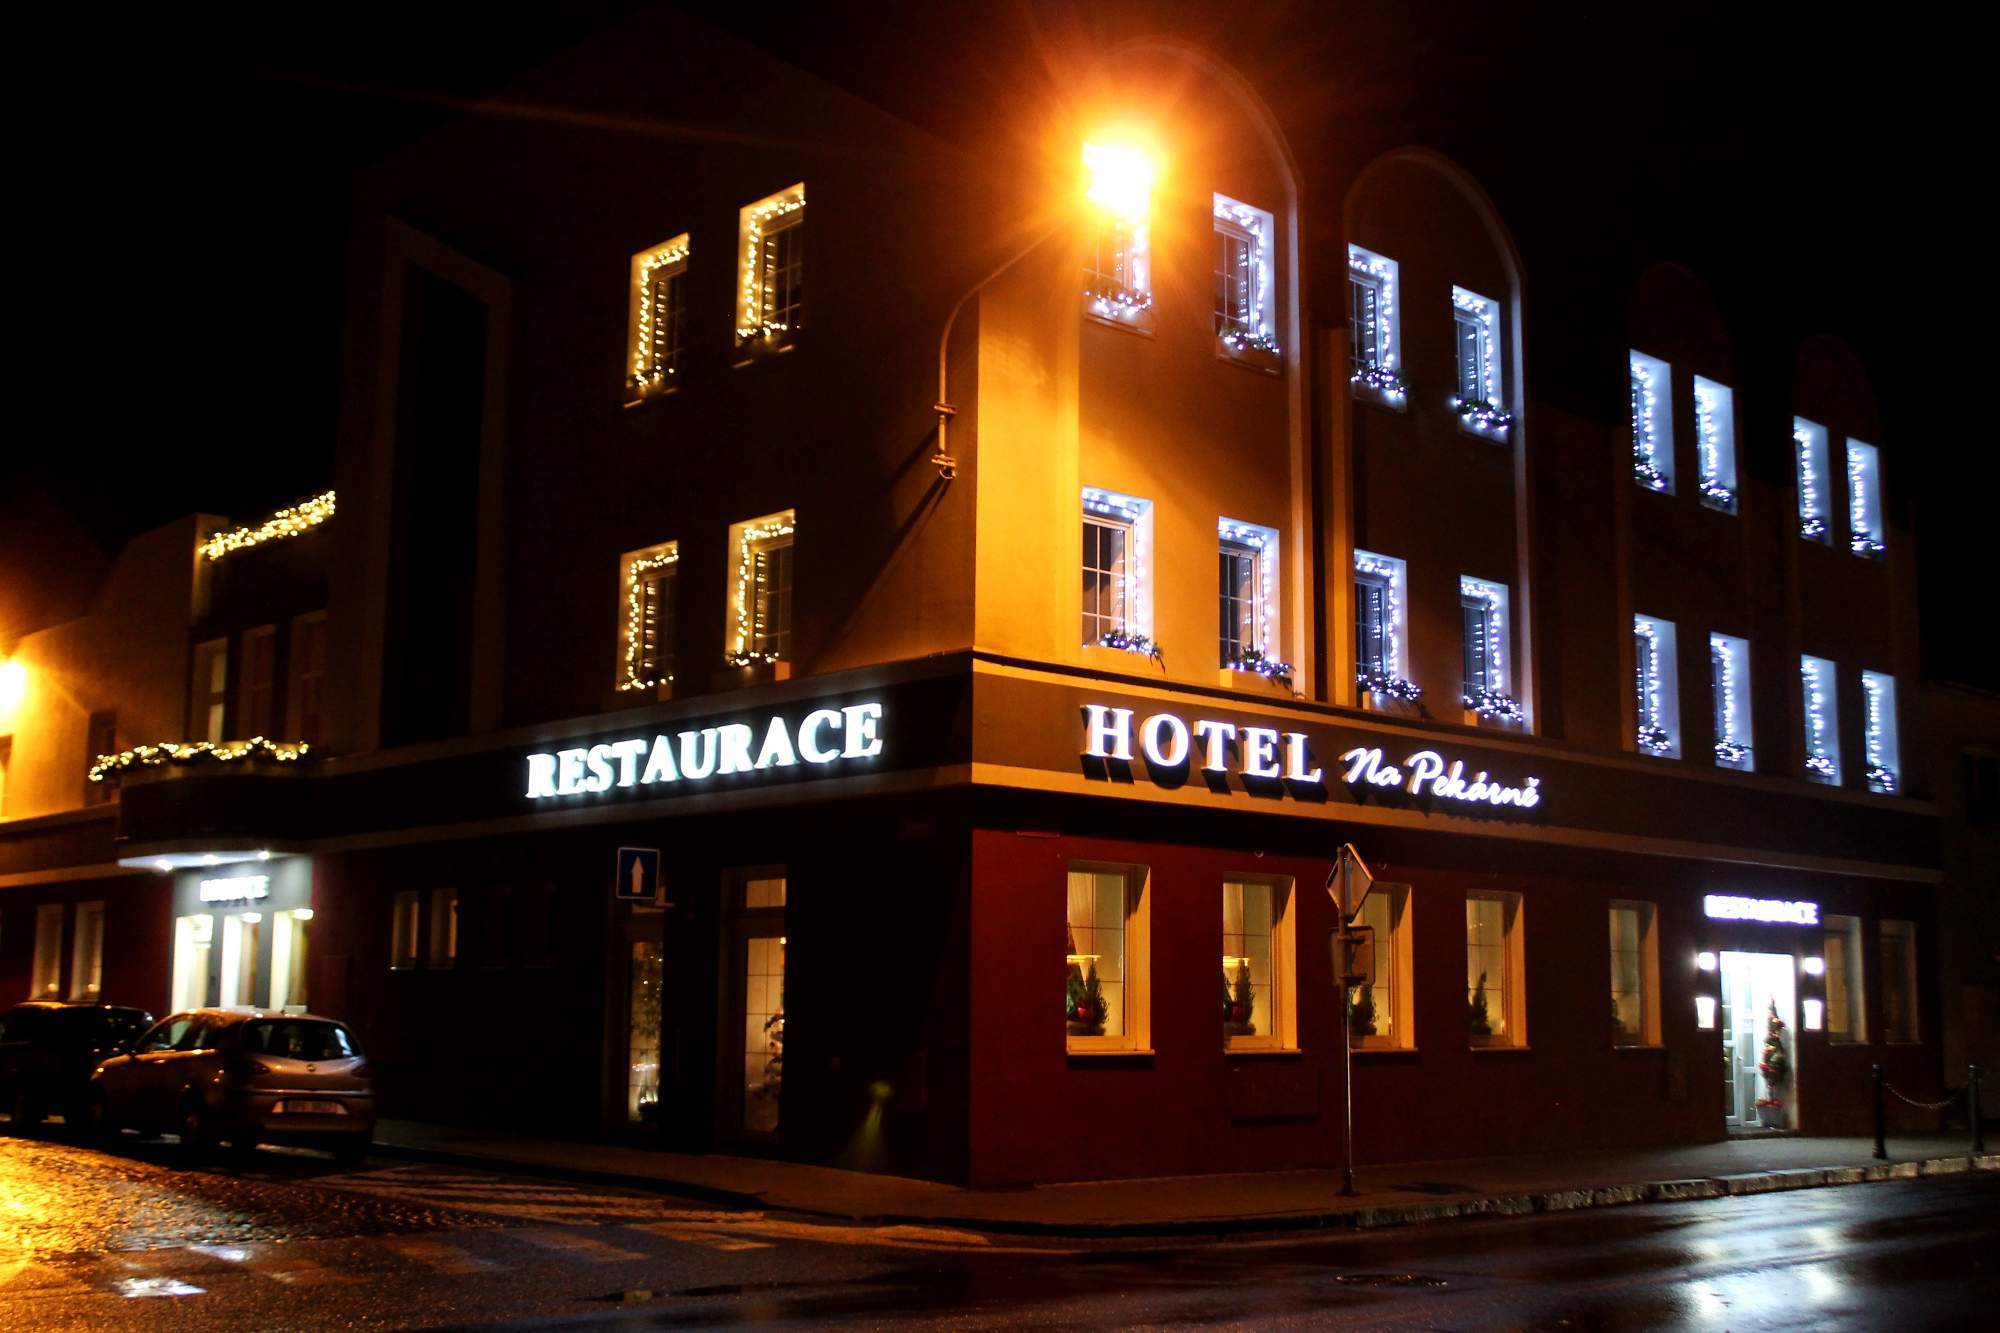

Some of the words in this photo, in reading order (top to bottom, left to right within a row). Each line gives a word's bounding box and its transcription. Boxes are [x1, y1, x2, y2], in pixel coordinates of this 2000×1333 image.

[525, 702, 883, 799] RESTAURACE
[1080, 704, 1322, 783] HOTEL
[1343, 747, 1402, 787] Na
[1407, 750, 1540, 808] Pekárně
